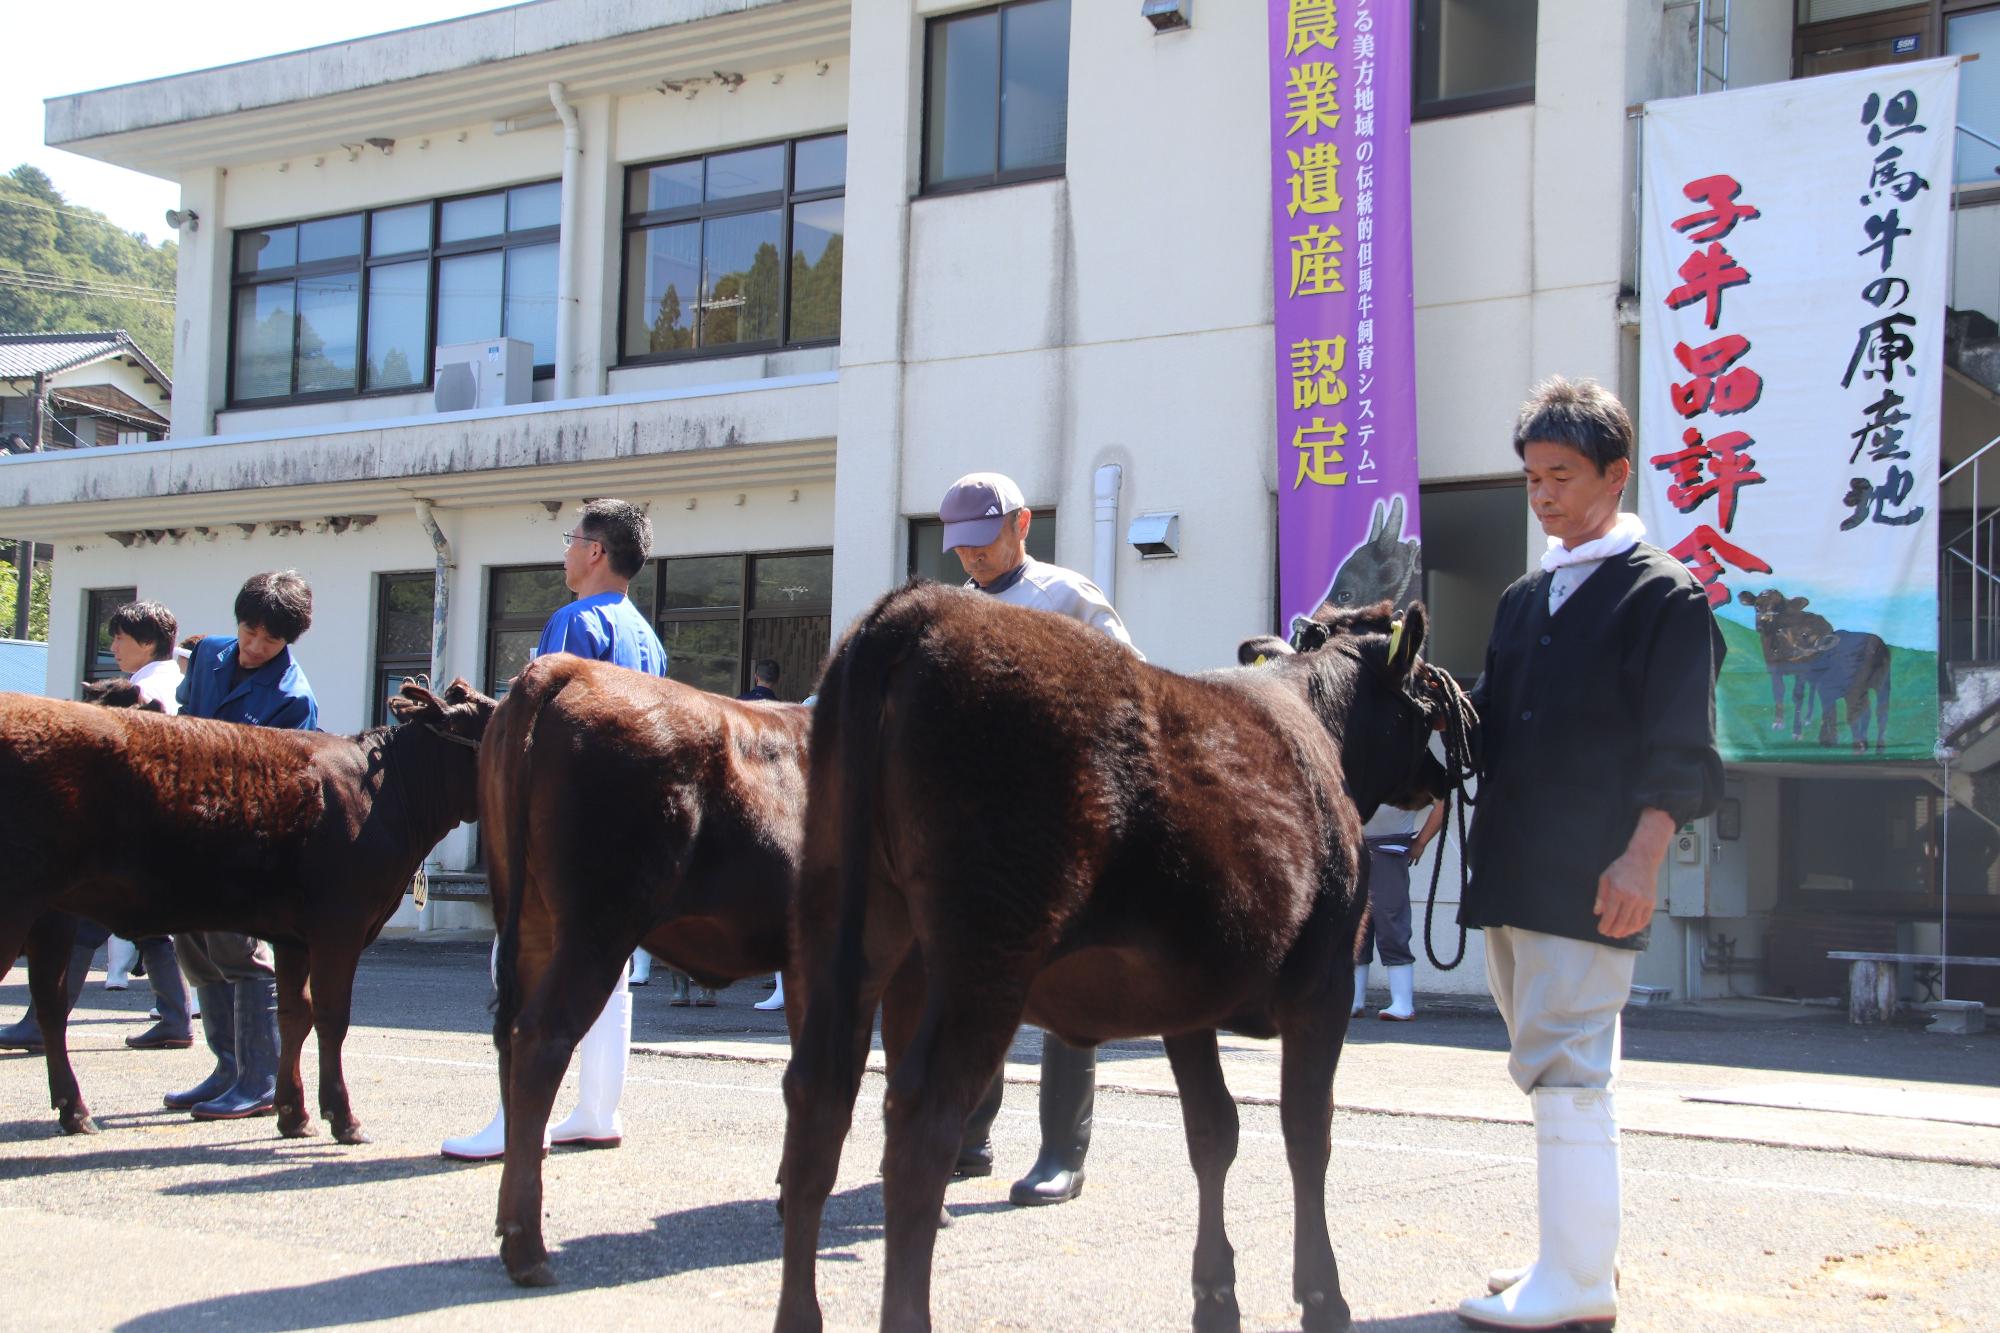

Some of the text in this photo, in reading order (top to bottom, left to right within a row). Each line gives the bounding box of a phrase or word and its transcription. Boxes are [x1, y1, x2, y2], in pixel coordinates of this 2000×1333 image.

[1353, 0, 1378, 485] る美方地域の伝統的但馬牛飼育システム」
[1840, 89, 1930, 531] 但馬牛の原産地
